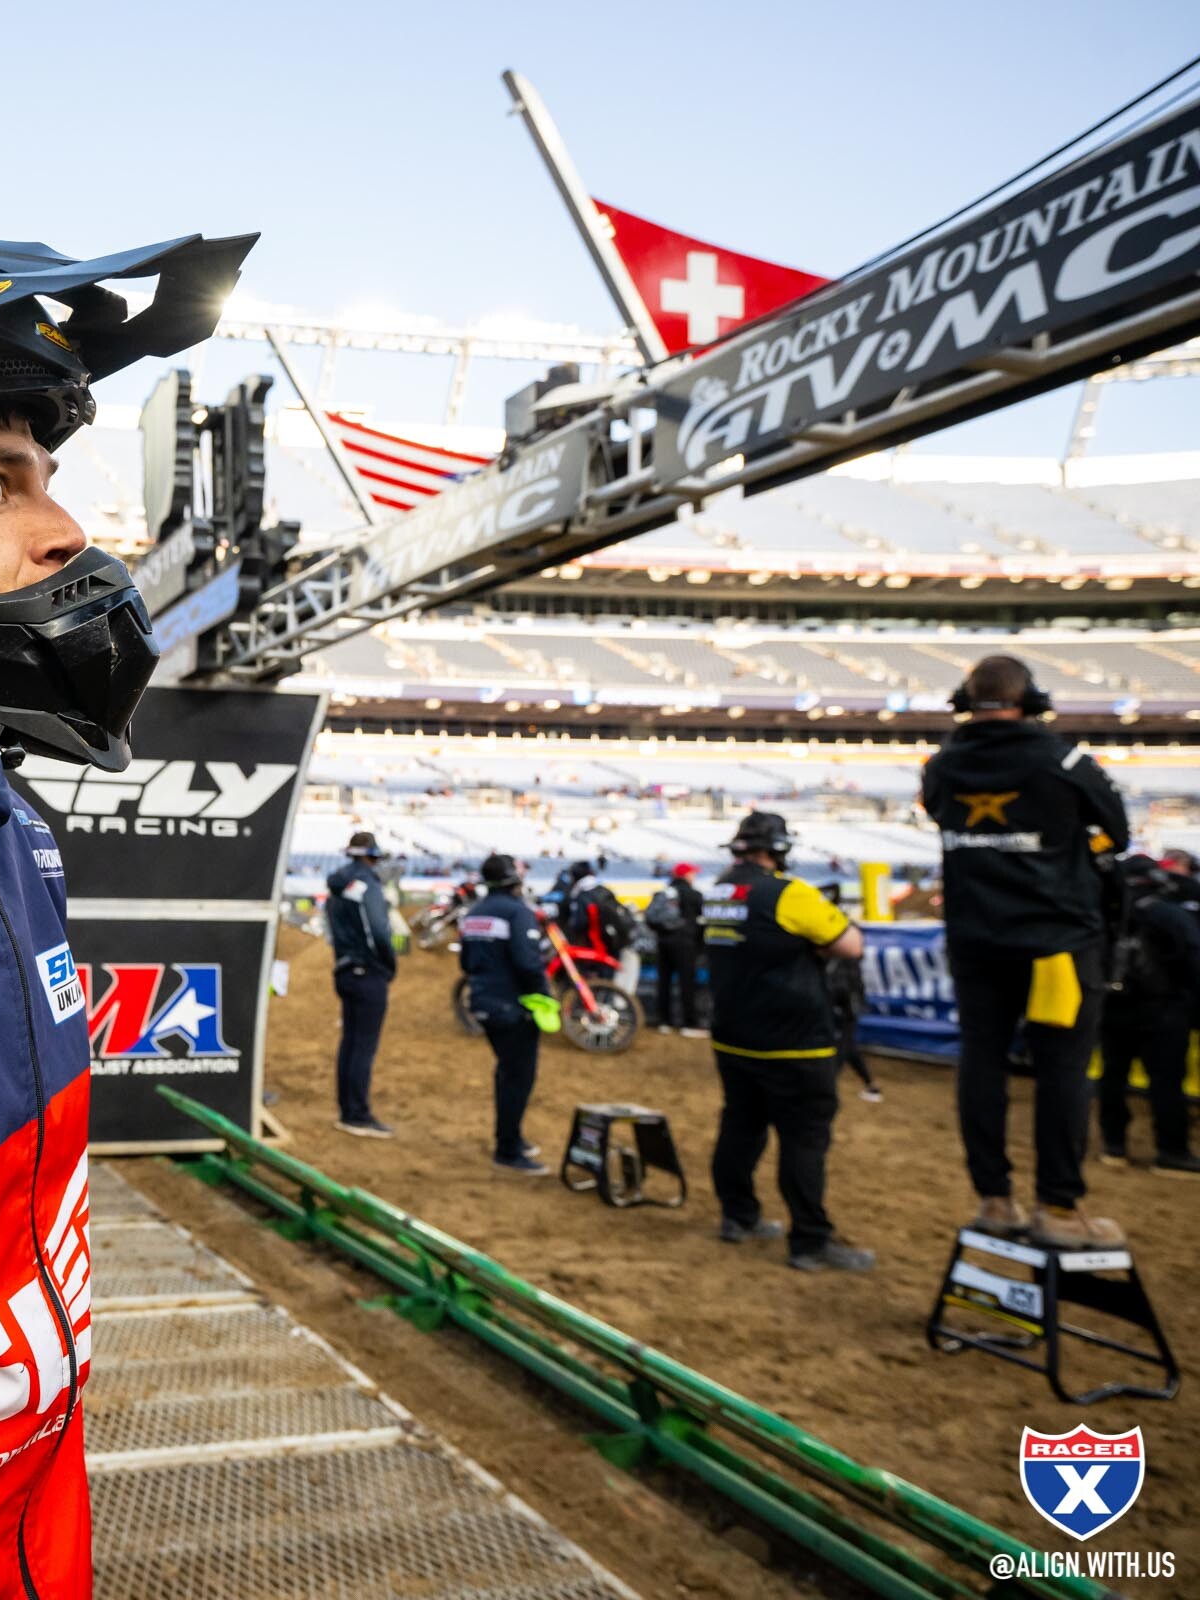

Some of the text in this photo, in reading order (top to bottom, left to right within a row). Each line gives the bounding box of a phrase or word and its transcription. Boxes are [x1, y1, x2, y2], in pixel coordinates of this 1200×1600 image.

[734, 296, 878, 390] ROCKY
[14, 756, 298, 819] FLY
[66, 815, 240, 837] RACING
